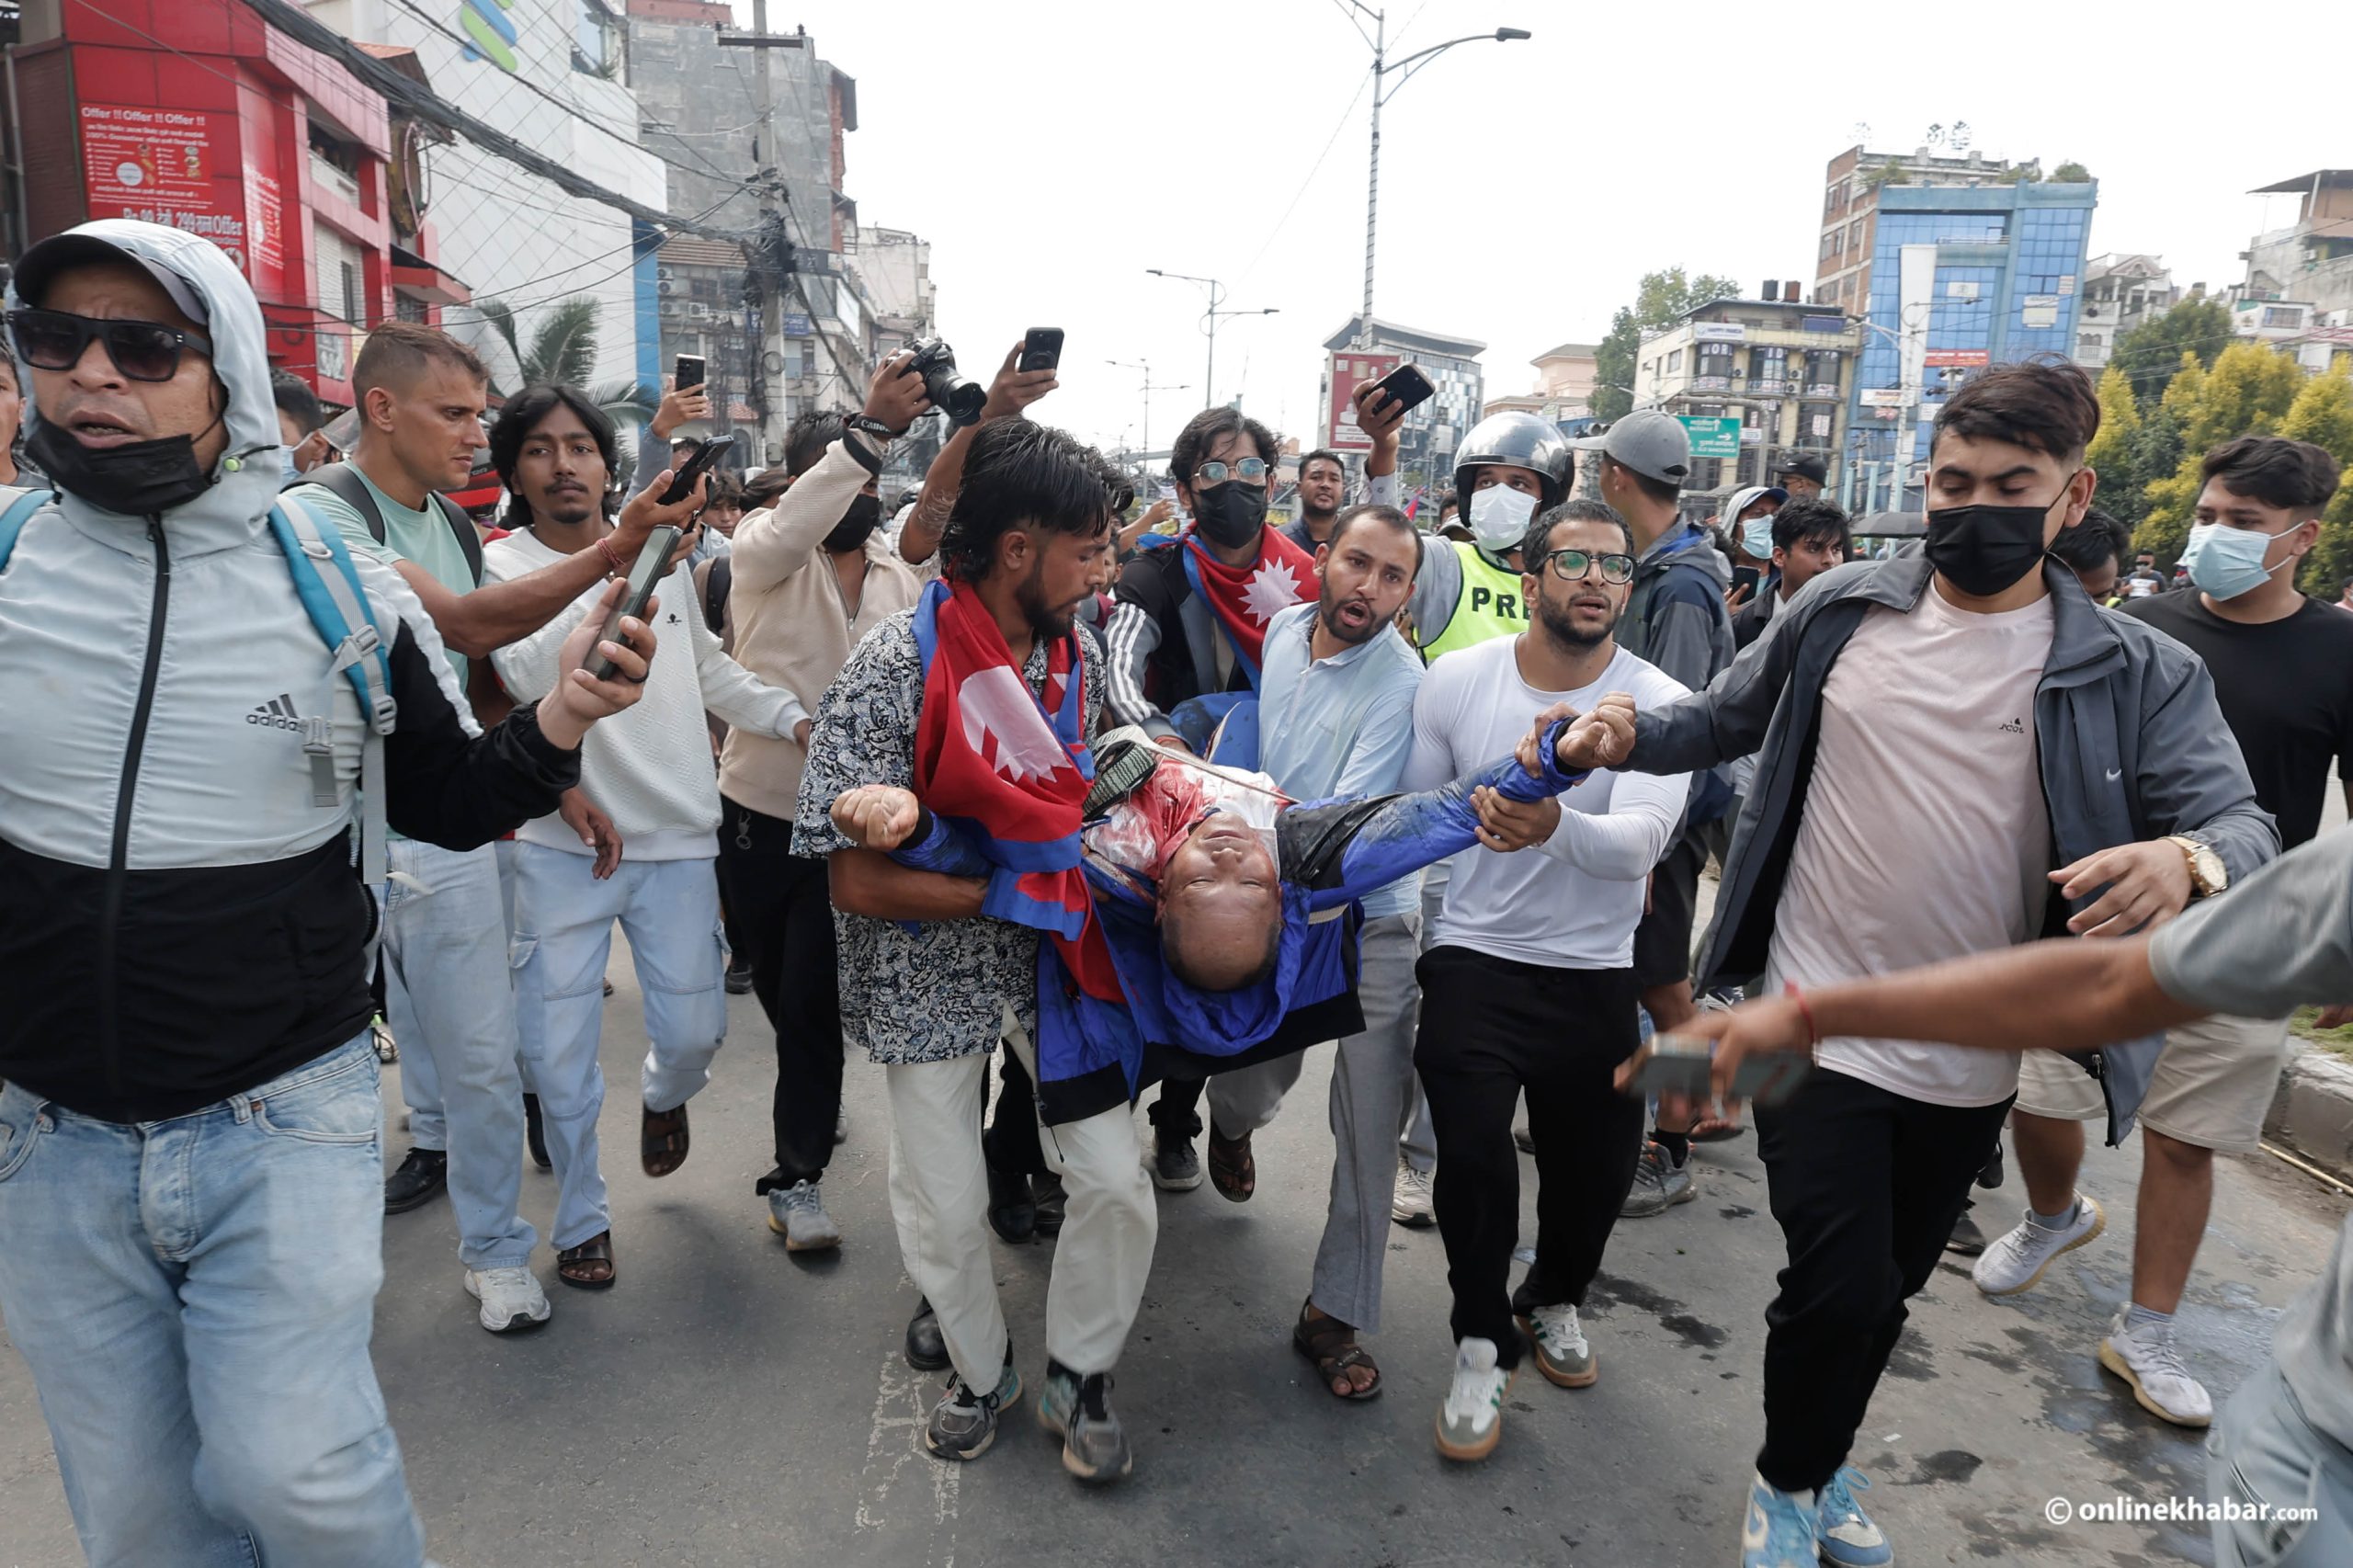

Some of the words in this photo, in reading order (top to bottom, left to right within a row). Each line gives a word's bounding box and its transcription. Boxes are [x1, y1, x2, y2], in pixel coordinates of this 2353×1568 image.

[81, 107, 111, 119] Offer
[122, 110, 153, 122] Offer
[165, 114, 195, 126] Offer
[212, 215, 243, 235] Offer
